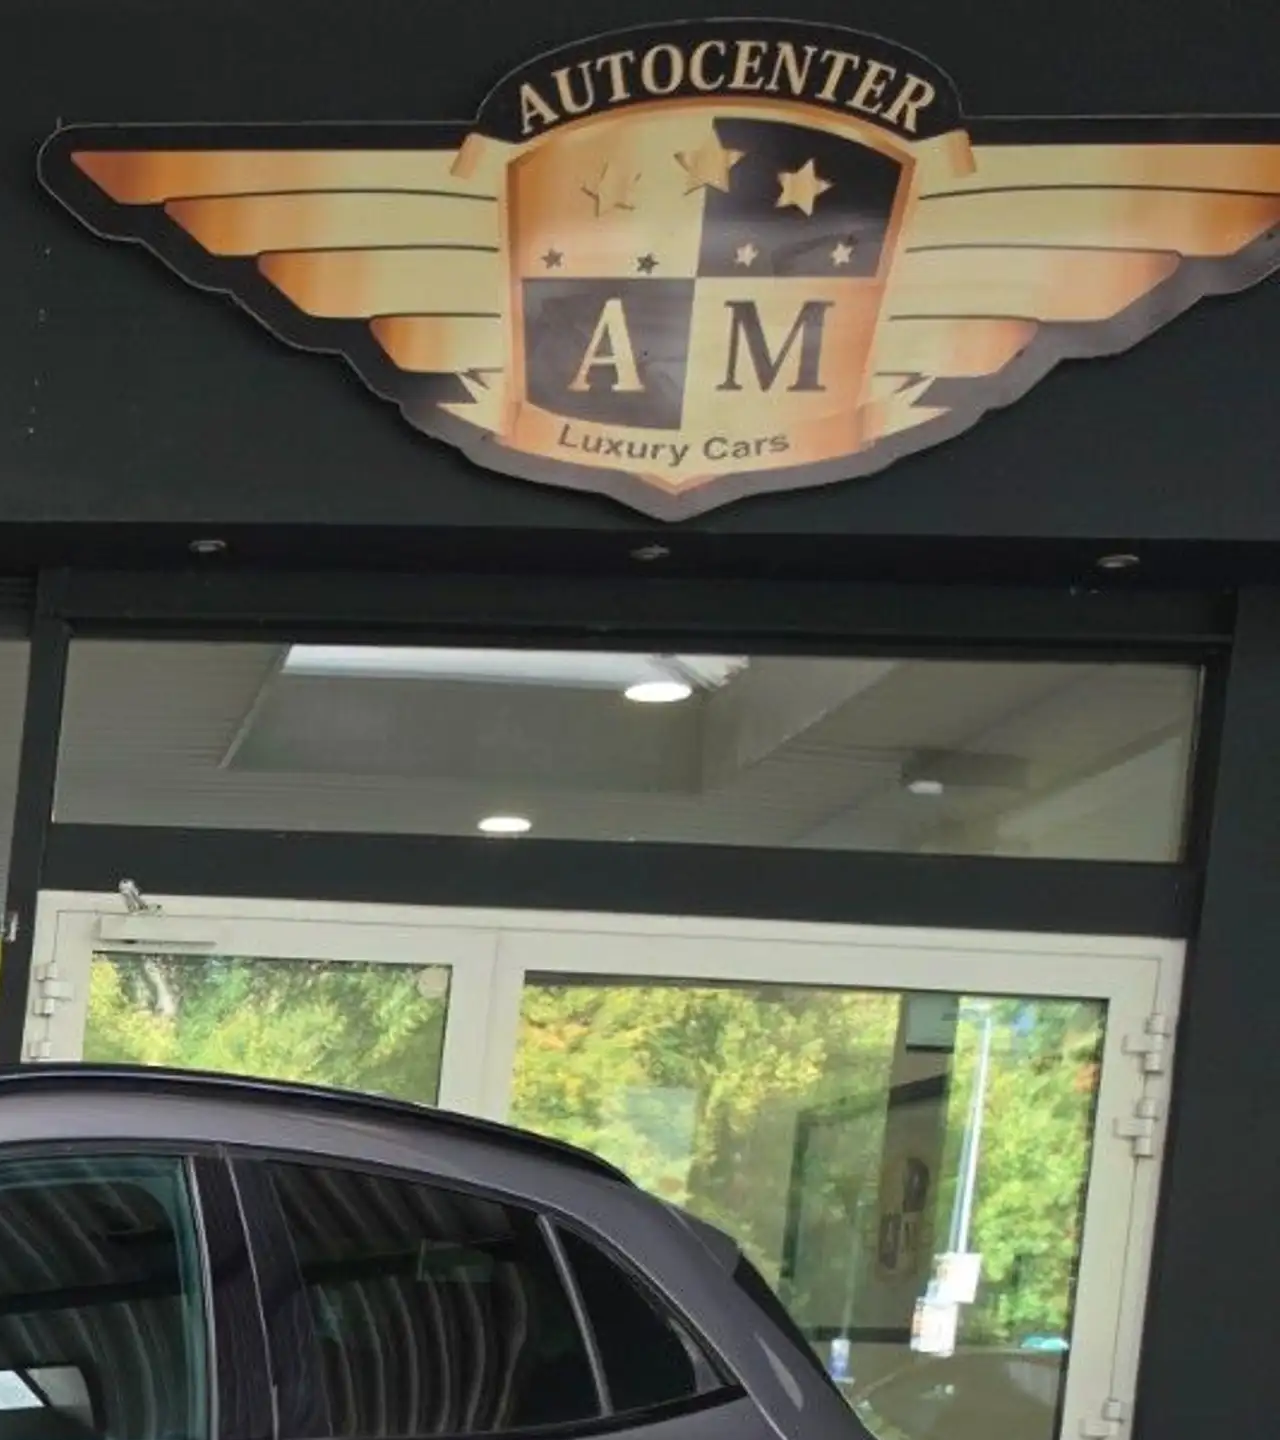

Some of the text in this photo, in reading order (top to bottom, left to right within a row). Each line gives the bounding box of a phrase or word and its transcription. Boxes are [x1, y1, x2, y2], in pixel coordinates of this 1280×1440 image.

[519, 41, 937, 133] AUTOCENTER
[567, 298, 835, 392] A M
[558, 423, 790, 467] Luxury Cars
